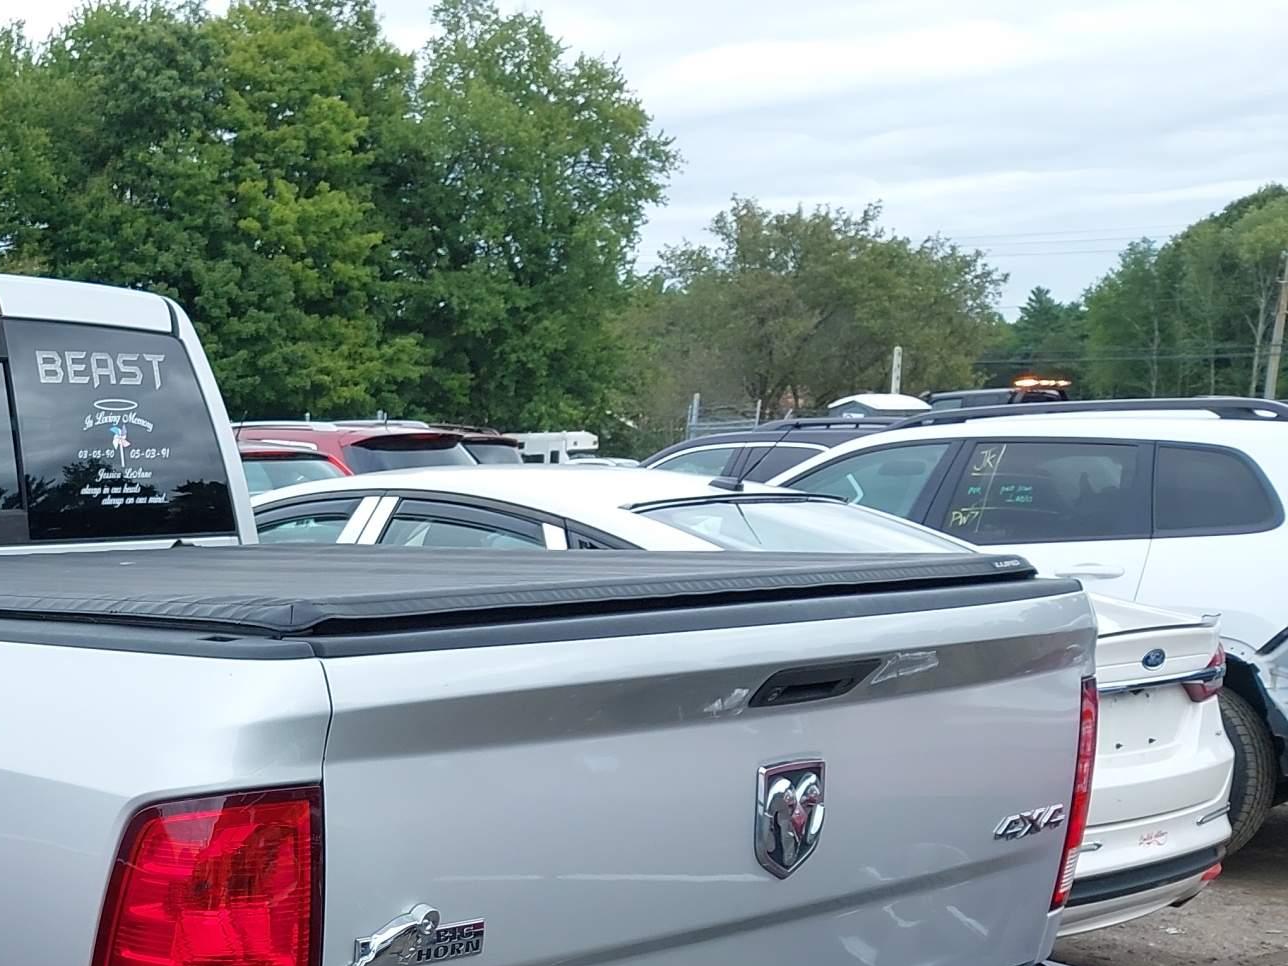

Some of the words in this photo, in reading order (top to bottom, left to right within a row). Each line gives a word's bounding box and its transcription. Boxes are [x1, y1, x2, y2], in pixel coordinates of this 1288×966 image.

[35, 349, 166, 391] BEAST
[94, 411, 121, 426] Loving
[122, 412, 154, 433] Memory
[435, 925, 476, 945] BIG
[416, 939, 481, 964] HORN
